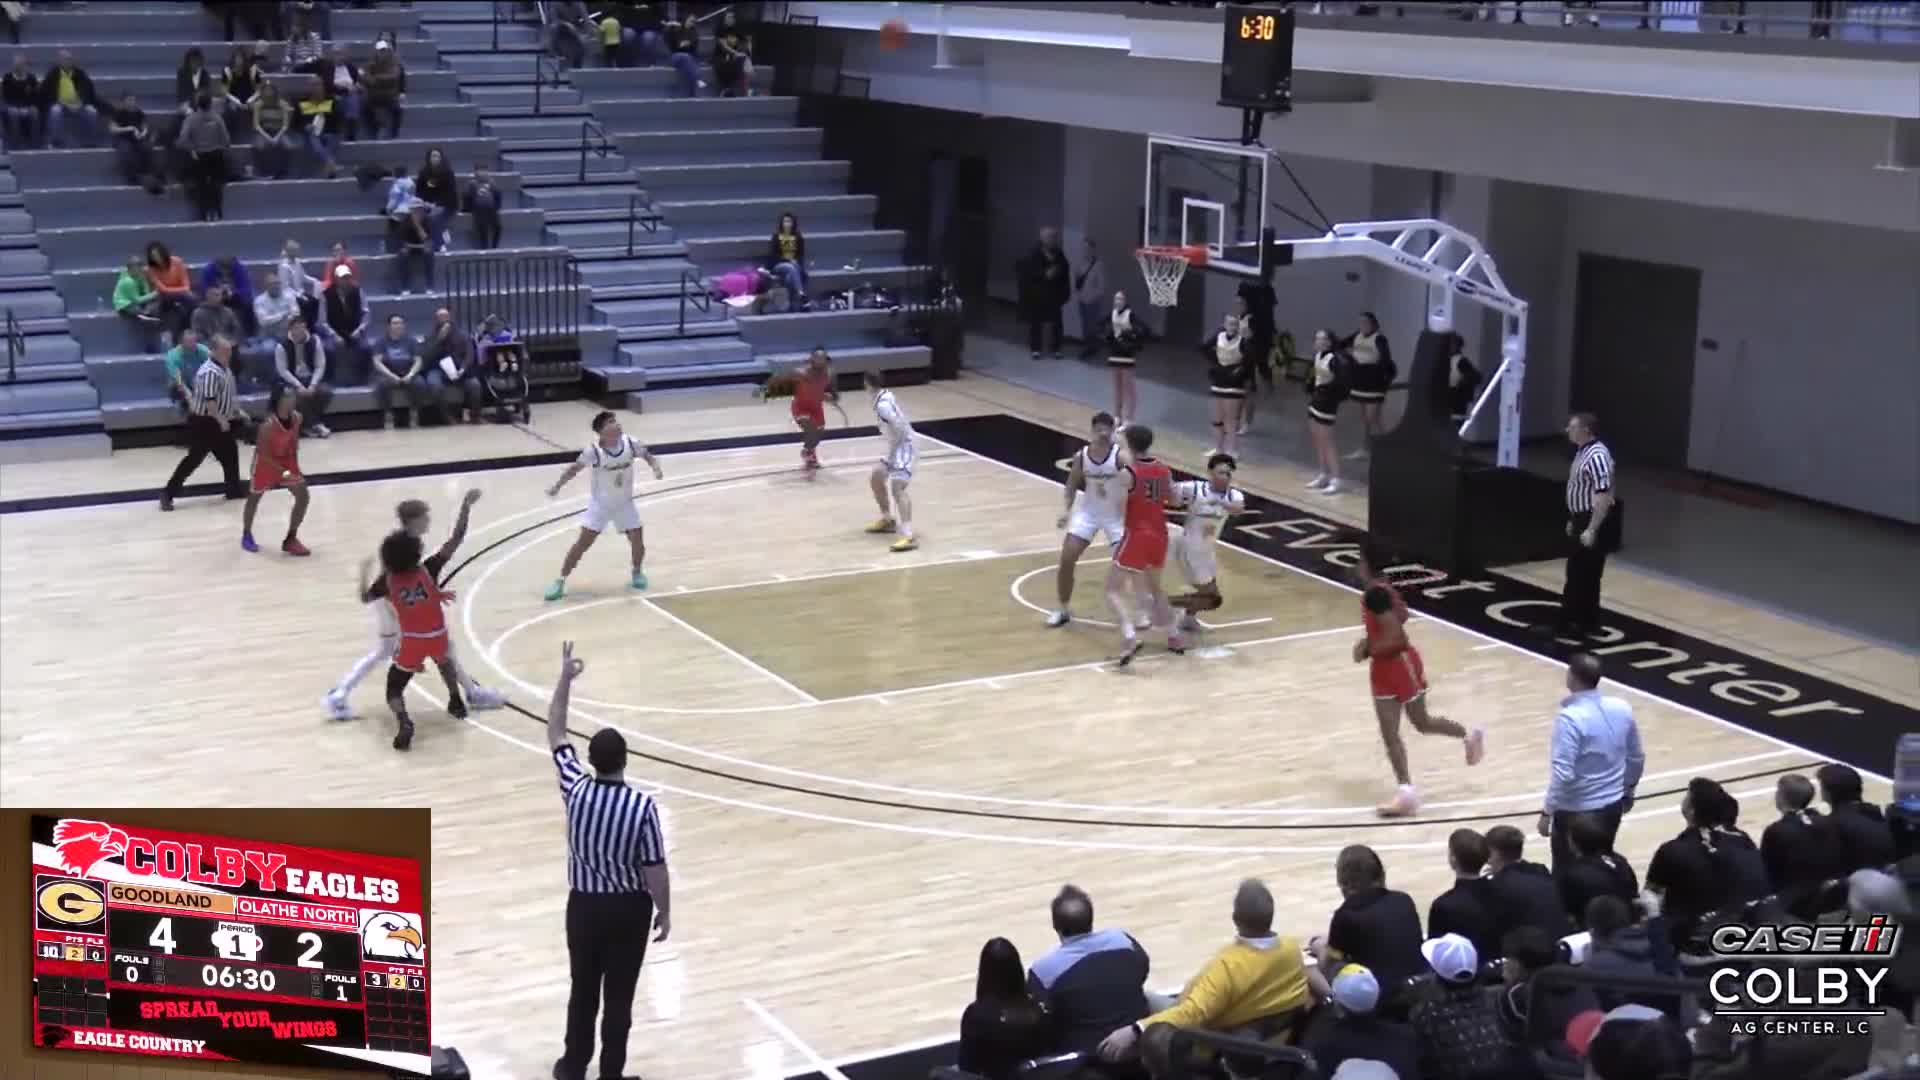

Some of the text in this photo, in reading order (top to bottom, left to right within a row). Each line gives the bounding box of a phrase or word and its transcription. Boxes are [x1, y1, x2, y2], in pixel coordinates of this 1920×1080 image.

[1241, 15, 1275, 40] 6:30
[399, 582, 428, 606] 24
[124, 837, 400, 904] COLBY EAGLES
[111, 886, 212, 909] GOODLAND
[239, 900, 357, 926] OLATHE NORTH
[149, 917, 177, 955] 4
[220, 923, 254, 933] PERIOD
[65, 935, 104, 946] PTS FLS
[229, 934, 247, 958] 1
[296, 931, 325, 969] 2
[71, 949, 80, 959] 2
[92, 950, 100, 961] 0
[114, 954, 149, 966] FOULS
[126, 966, 139, 983] 0
[202, 963, 276, 992] 06:30
[324, 974, 357, 984] FOULS
[371, 973, 421, 988] 3 2 0
[388, 966, 423, 977] PTS FLS
[336, 985, 348, 1001] 1
[140, 999, 220, 1019] SPREAD
[218, 1009, 272, 1029] YOUR
[271, 1020, 337, 1040] WINGS
[73, 1030, 207, 1054] EAGLE COUNTRY
